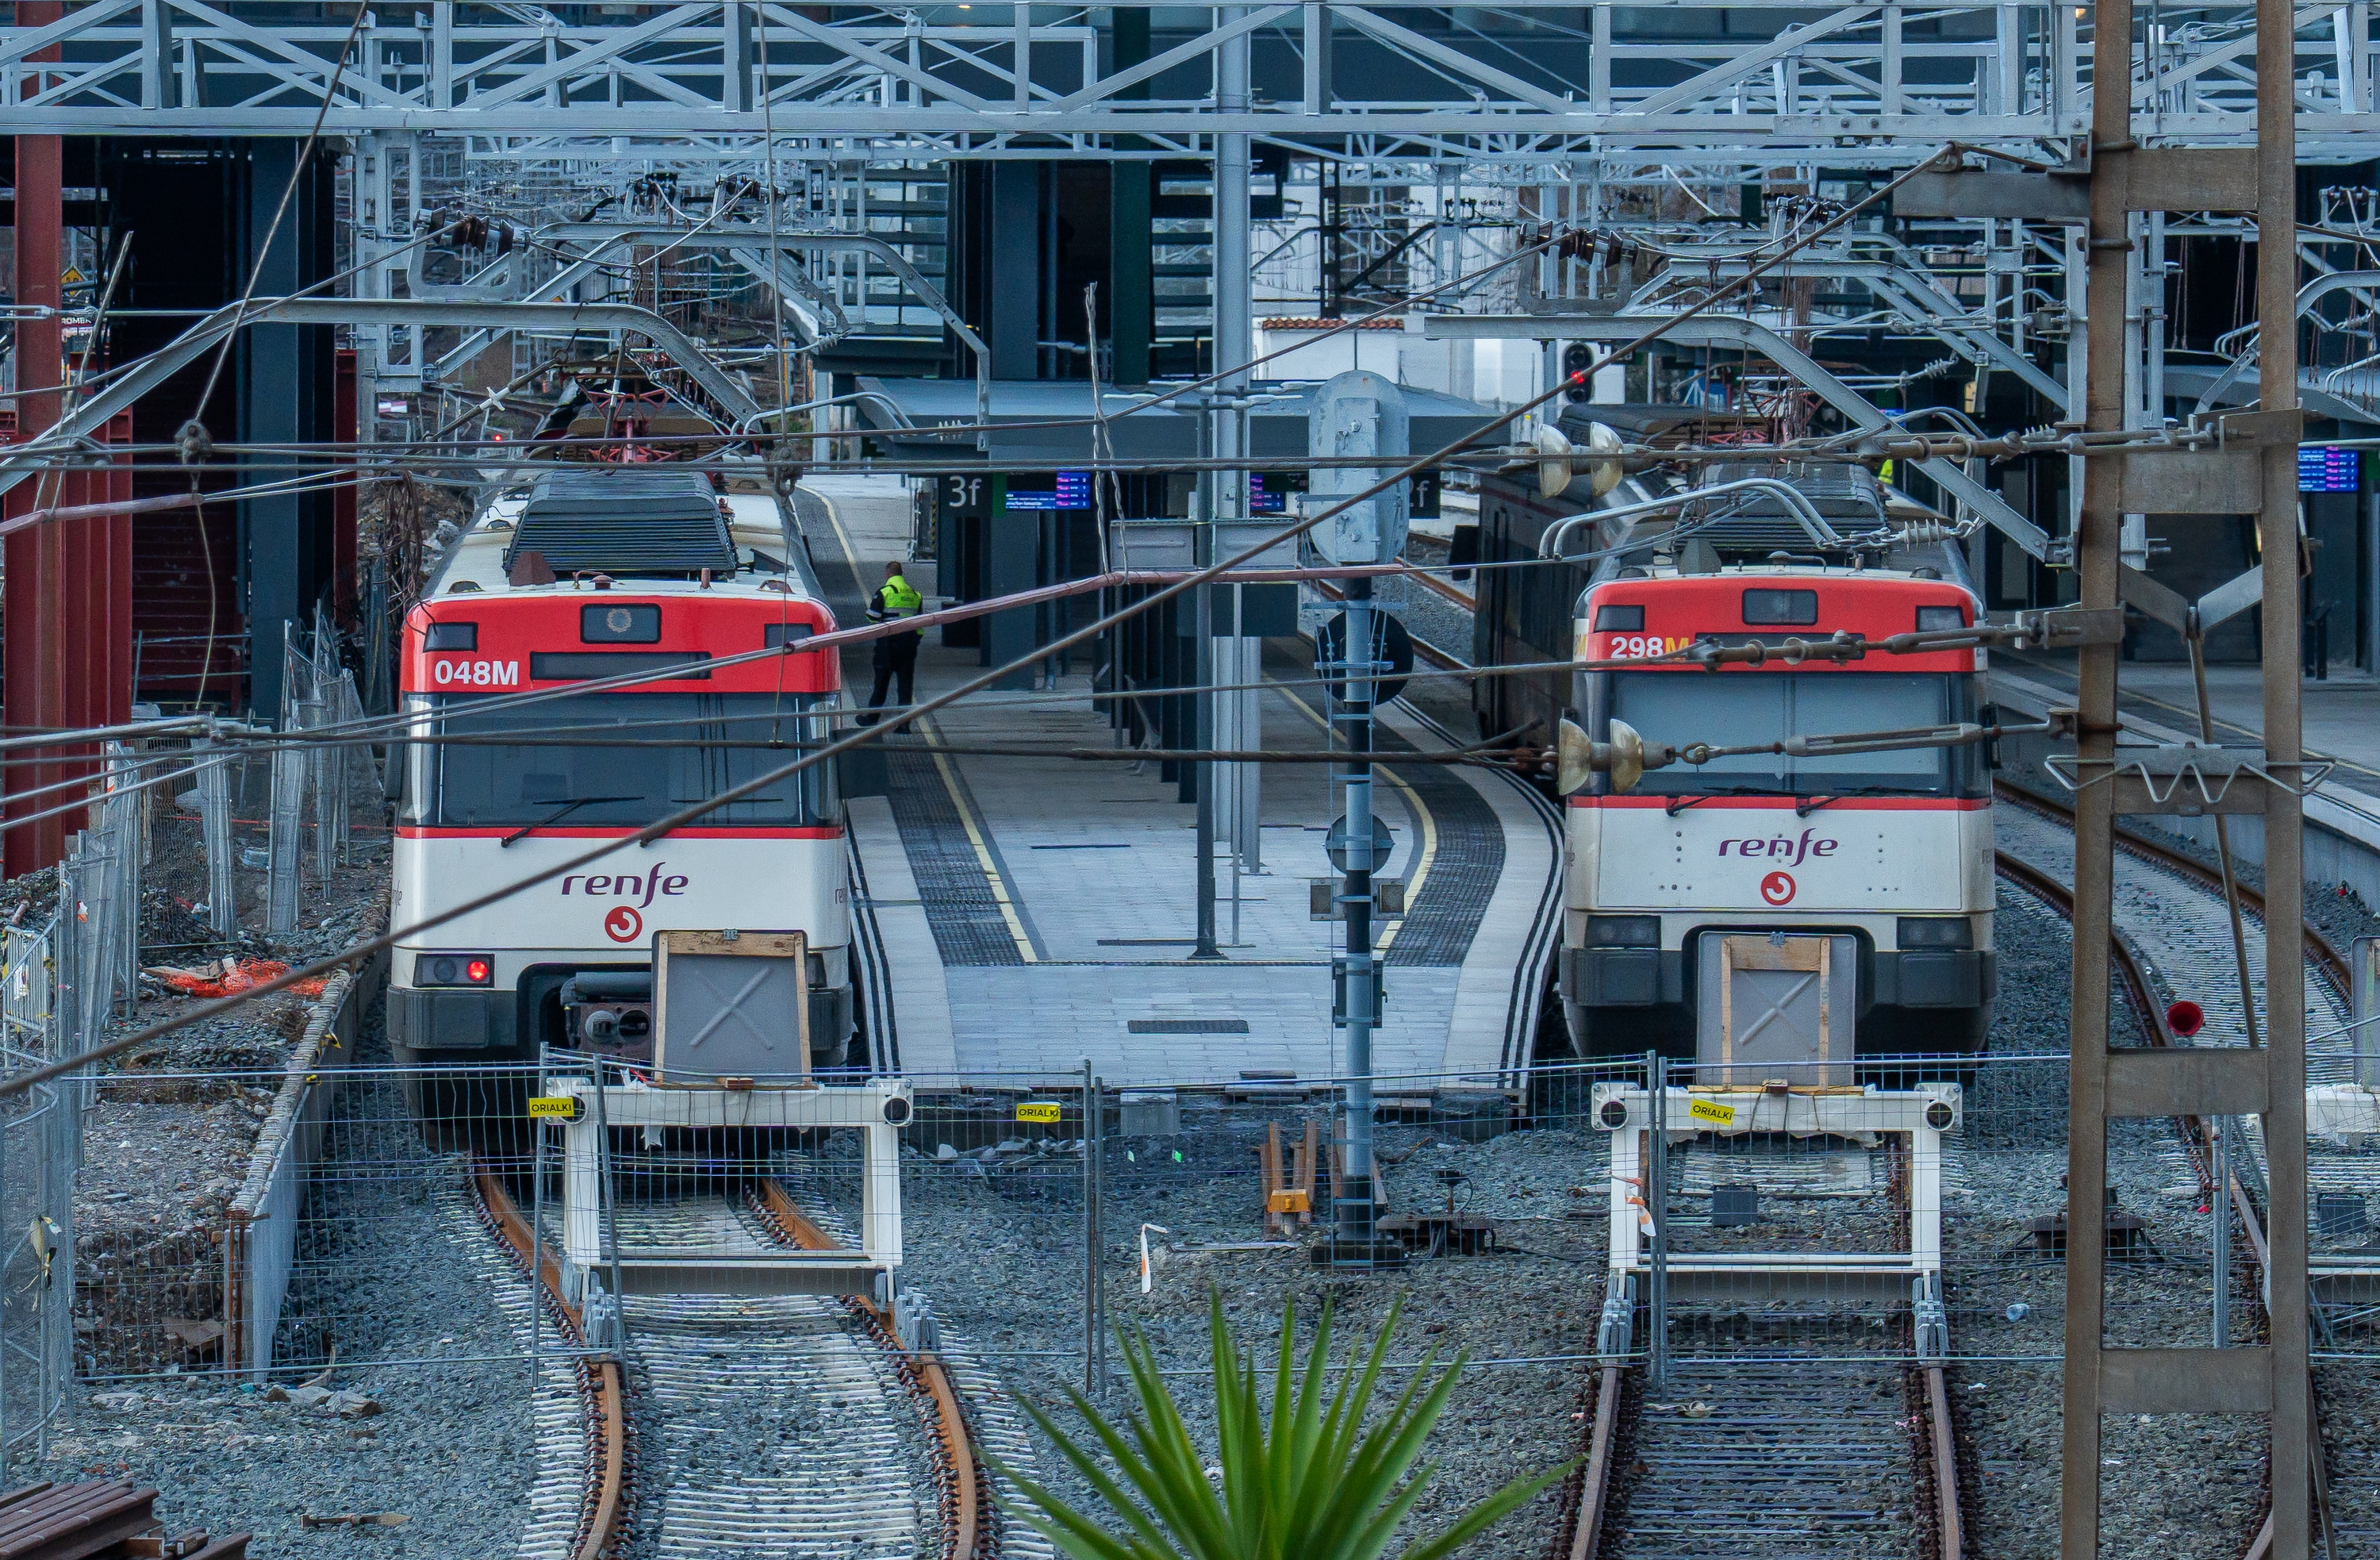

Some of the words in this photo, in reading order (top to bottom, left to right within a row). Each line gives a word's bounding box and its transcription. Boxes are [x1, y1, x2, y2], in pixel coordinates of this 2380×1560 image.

[949, 475, 982, 508] 3f
[1610, 636, 1690, 659] 298M
[435, 659, 519, 686] 048M
[1718, 828, 1838, 867] renfe
[561, 861, 689, 909] renfe
[532, 1103, 572, 1112] ORIALKI
[1692, 1105, 1733, 1120] ORIALKI
